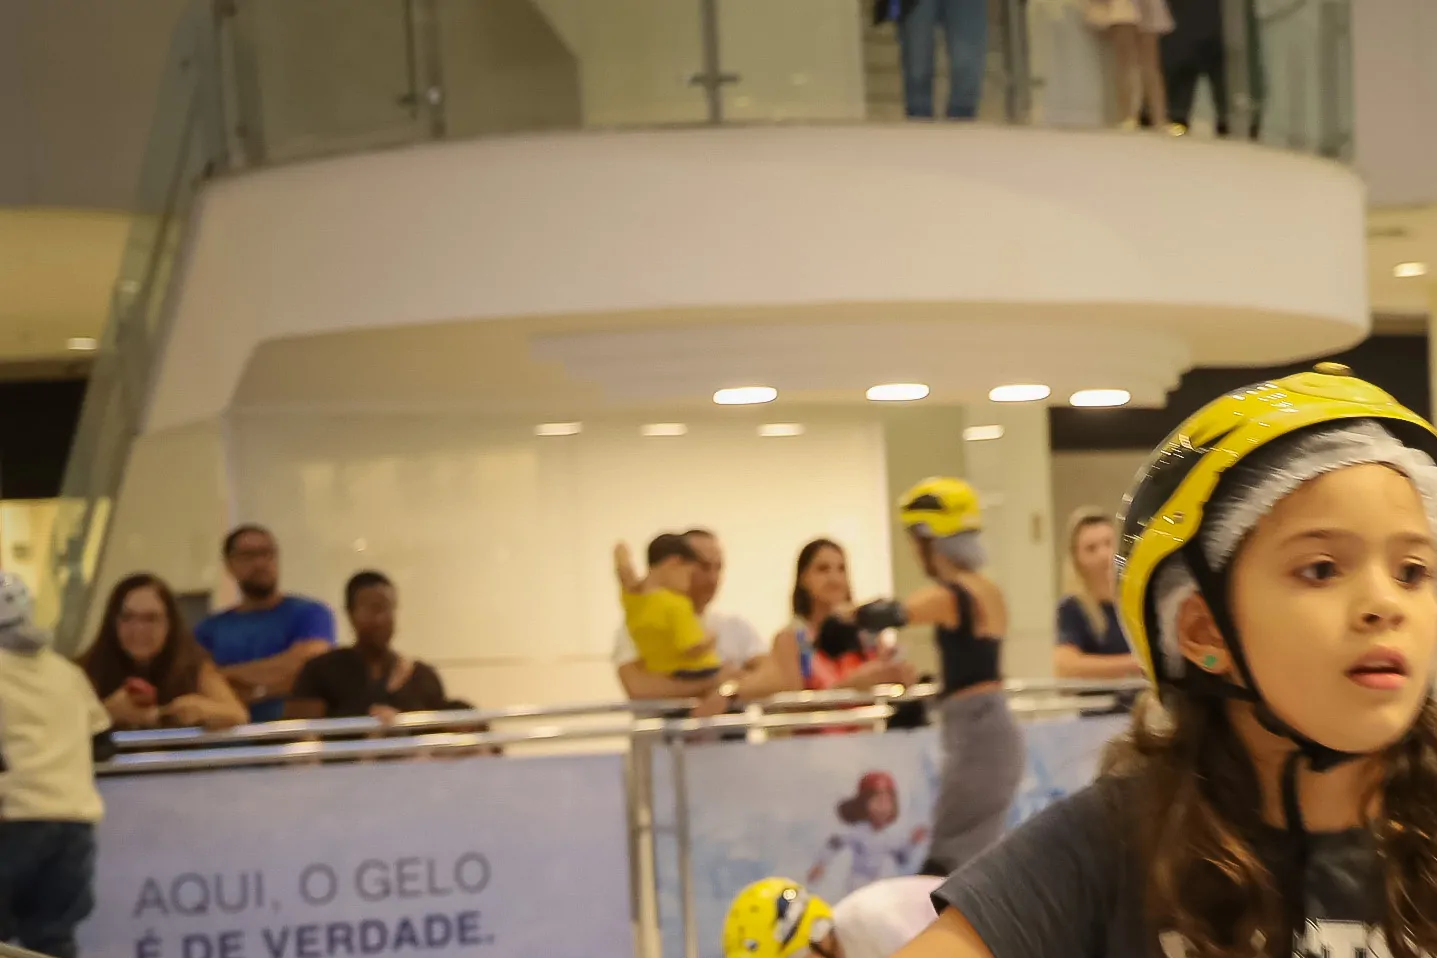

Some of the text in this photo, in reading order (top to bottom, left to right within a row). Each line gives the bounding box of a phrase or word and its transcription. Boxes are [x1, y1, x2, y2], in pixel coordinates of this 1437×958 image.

[134, 852, 491, 918] AQUI, O GELO
